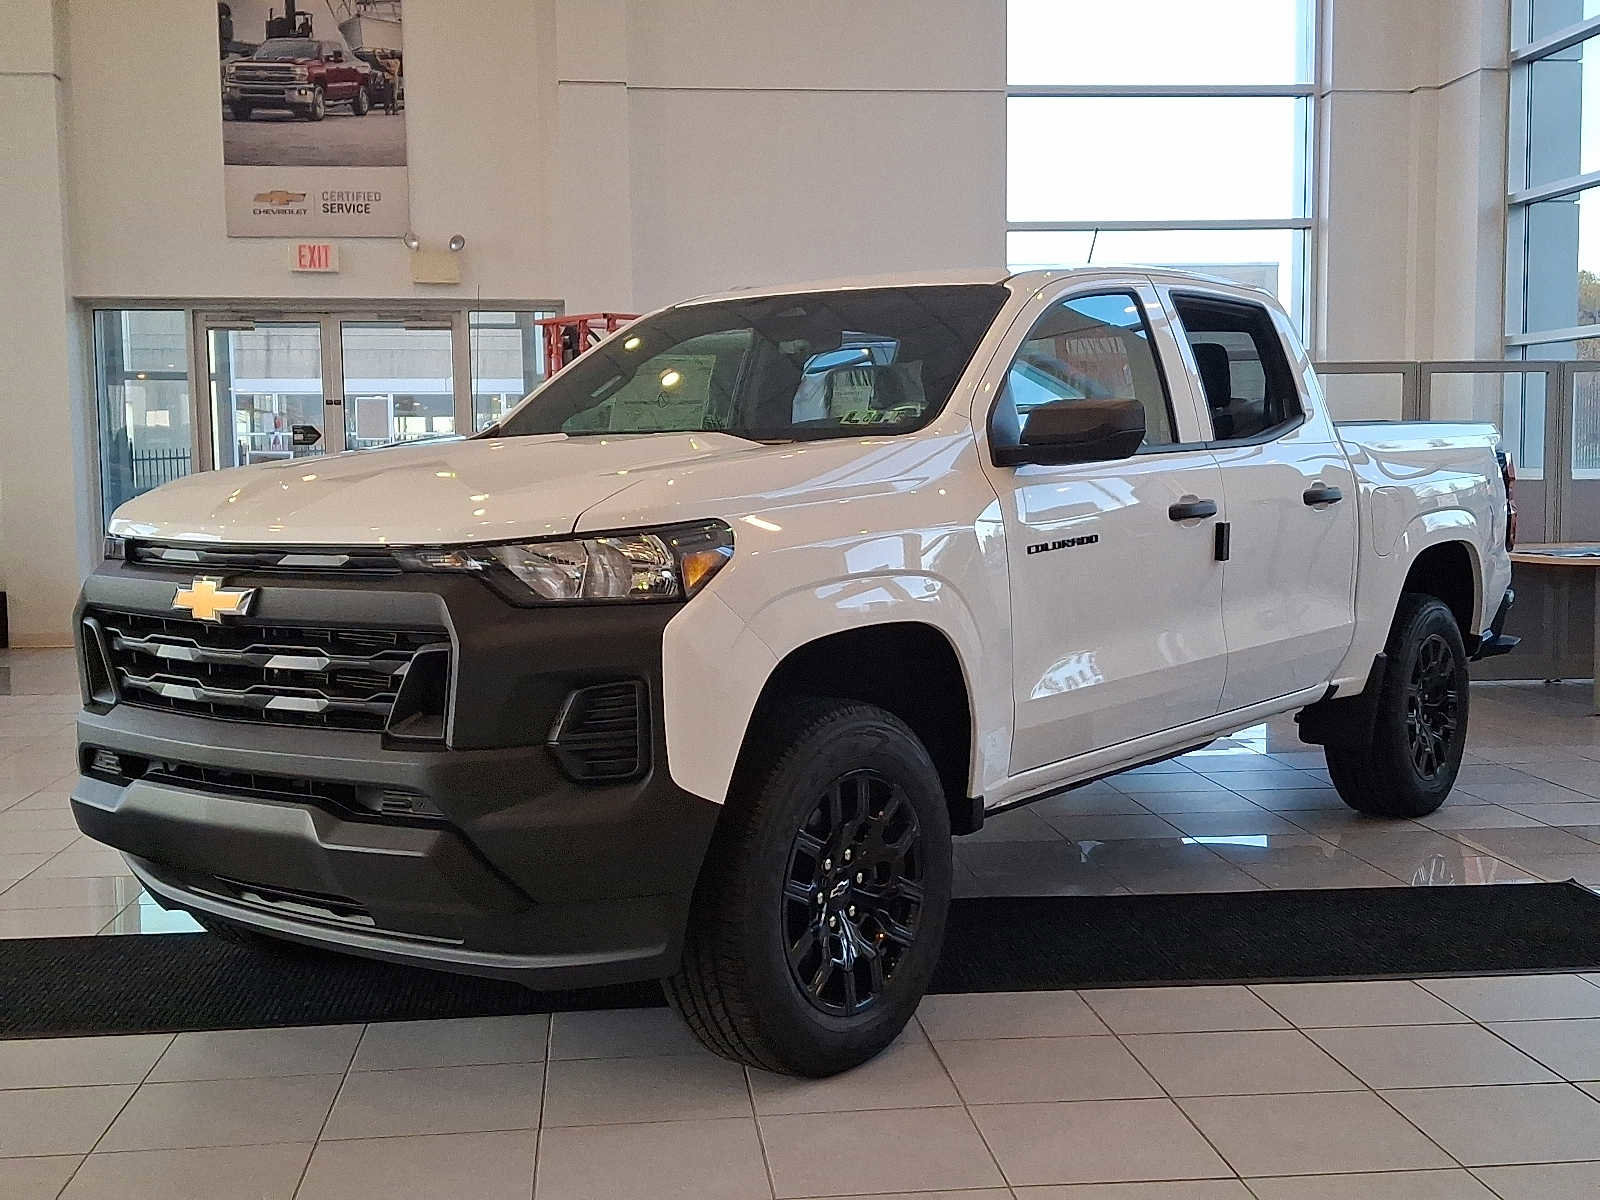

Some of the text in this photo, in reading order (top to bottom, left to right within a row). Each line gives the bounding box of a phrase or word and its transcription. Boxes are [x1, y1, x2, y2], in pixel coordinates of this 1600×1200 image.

[322, 191, 382, 202] CERTIFIED
[322, 203, 371, 214] SERVICE
[298, 244, 331, 269] EXIT
[1026, 534, 1099, 555] COLORADO
